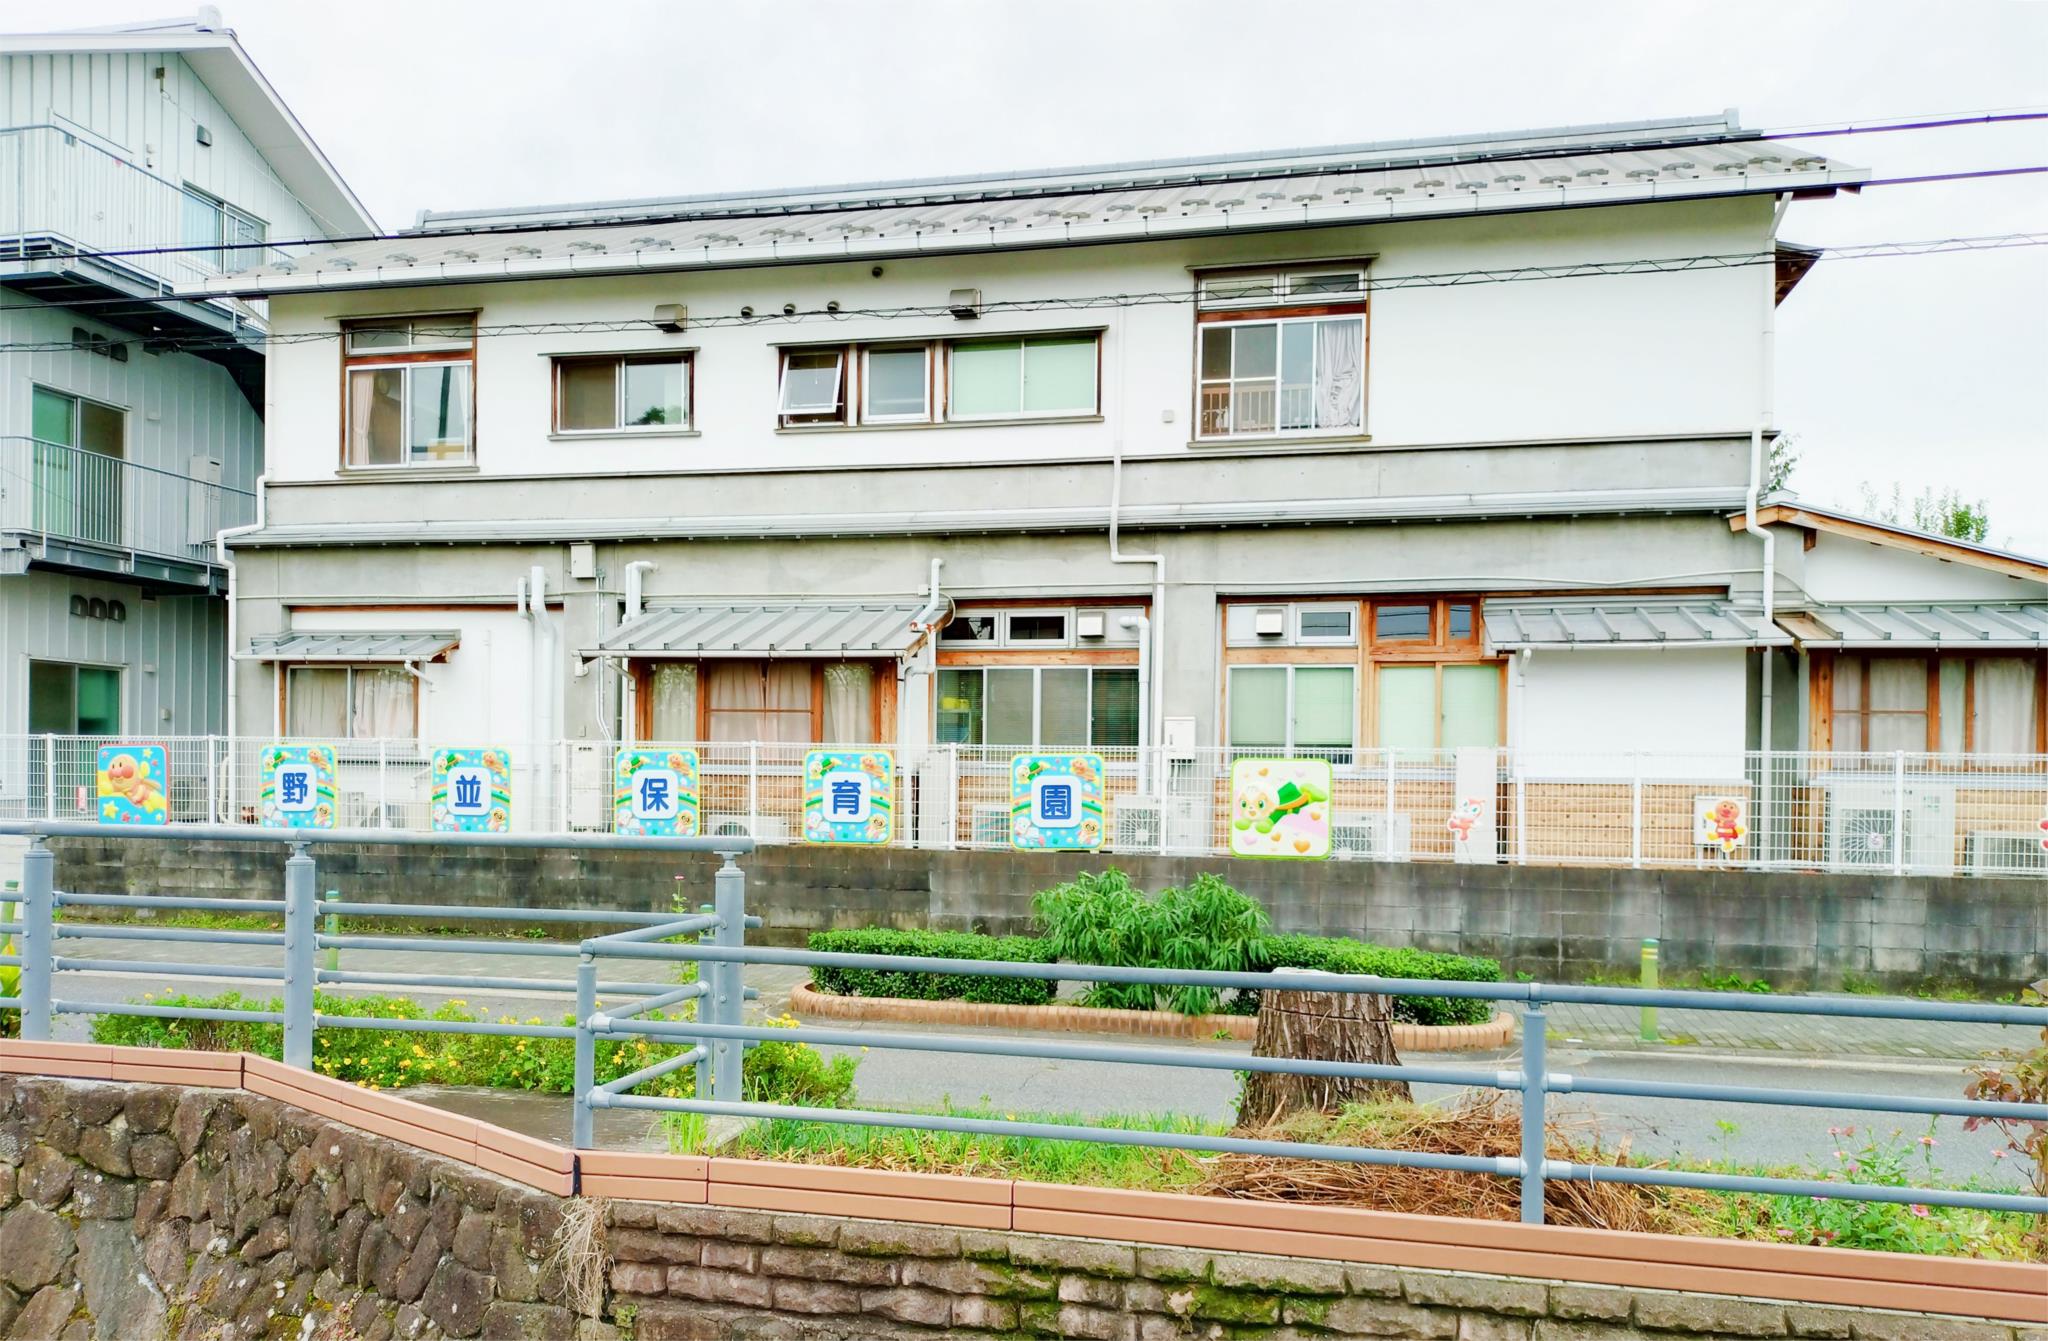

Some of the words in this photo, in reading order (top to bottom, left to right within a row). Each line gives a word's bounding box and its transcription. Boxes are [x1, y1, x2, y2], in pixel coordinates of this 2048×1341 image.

[282, 772, 308, 805] 野
[454, 774, 482, 808] 並
[639, 777, 669, 812] 保
[831, 779, 862, 816] 育
[1040, 784, 1072, 820] 園
